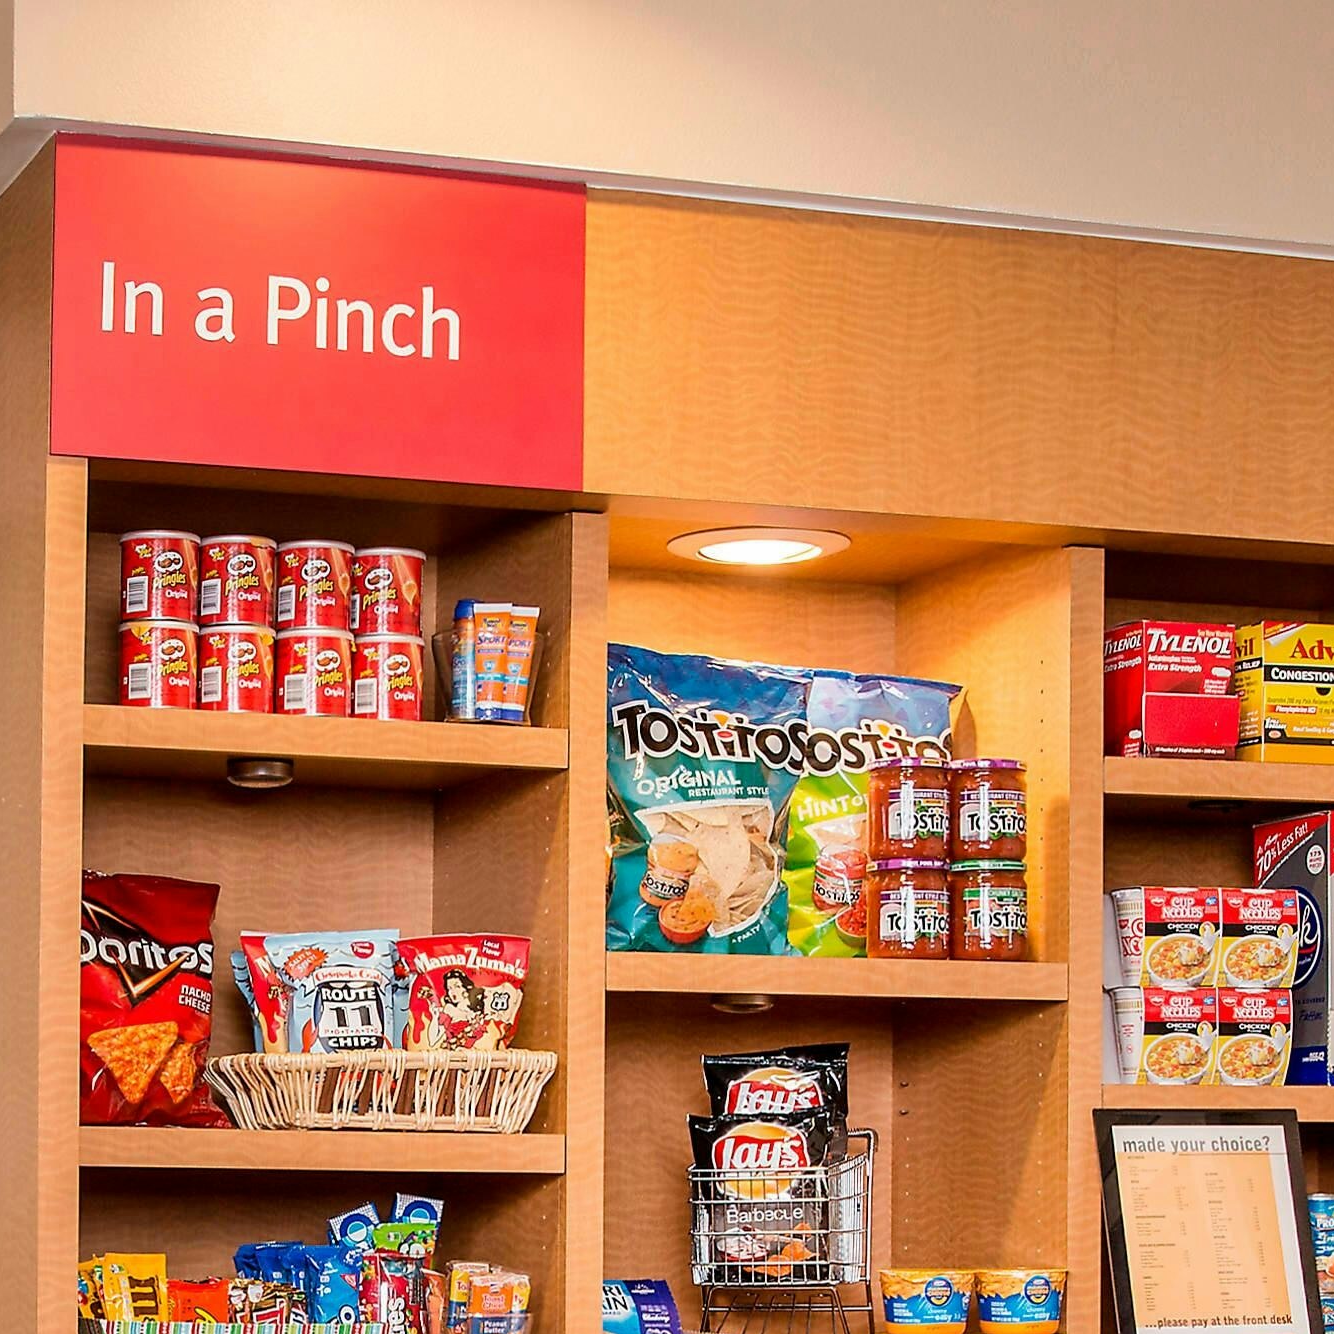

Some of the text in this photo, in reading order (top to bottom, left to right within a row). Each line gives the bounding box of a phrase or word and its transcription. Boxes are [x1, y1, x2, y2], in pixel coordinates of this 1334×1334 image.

[101, 261, 461, 361] In a Pinch
[1147, 629, 1232, 655] TYLENOL
[614, 701, 808, 772] TOSTITOS
[797, 796, 850, 822] HINT
[80, 929, 214, 974] Doritos
[181, 983, 212, 1003] NACHO
[321, 986, 377, 1001] ROUTE
[178, 994, 211, 1014] CHEESE
[329, 1005, 372, 1028] 11
[328, 1035, 379, 1048] CHIPS
[1123, 1135, 1271, 1155] made your choice?
[726, 1205, 804, 1224] Barbecue
[1191, 1318, 1208, 1328] pay
[1211, 1315, 1223, 1326] at
[1224, 1315, 1240, 1326] the
[1242, 1314, 1268, 1326] front
[1270, 1313, 1293, 1325] desk
